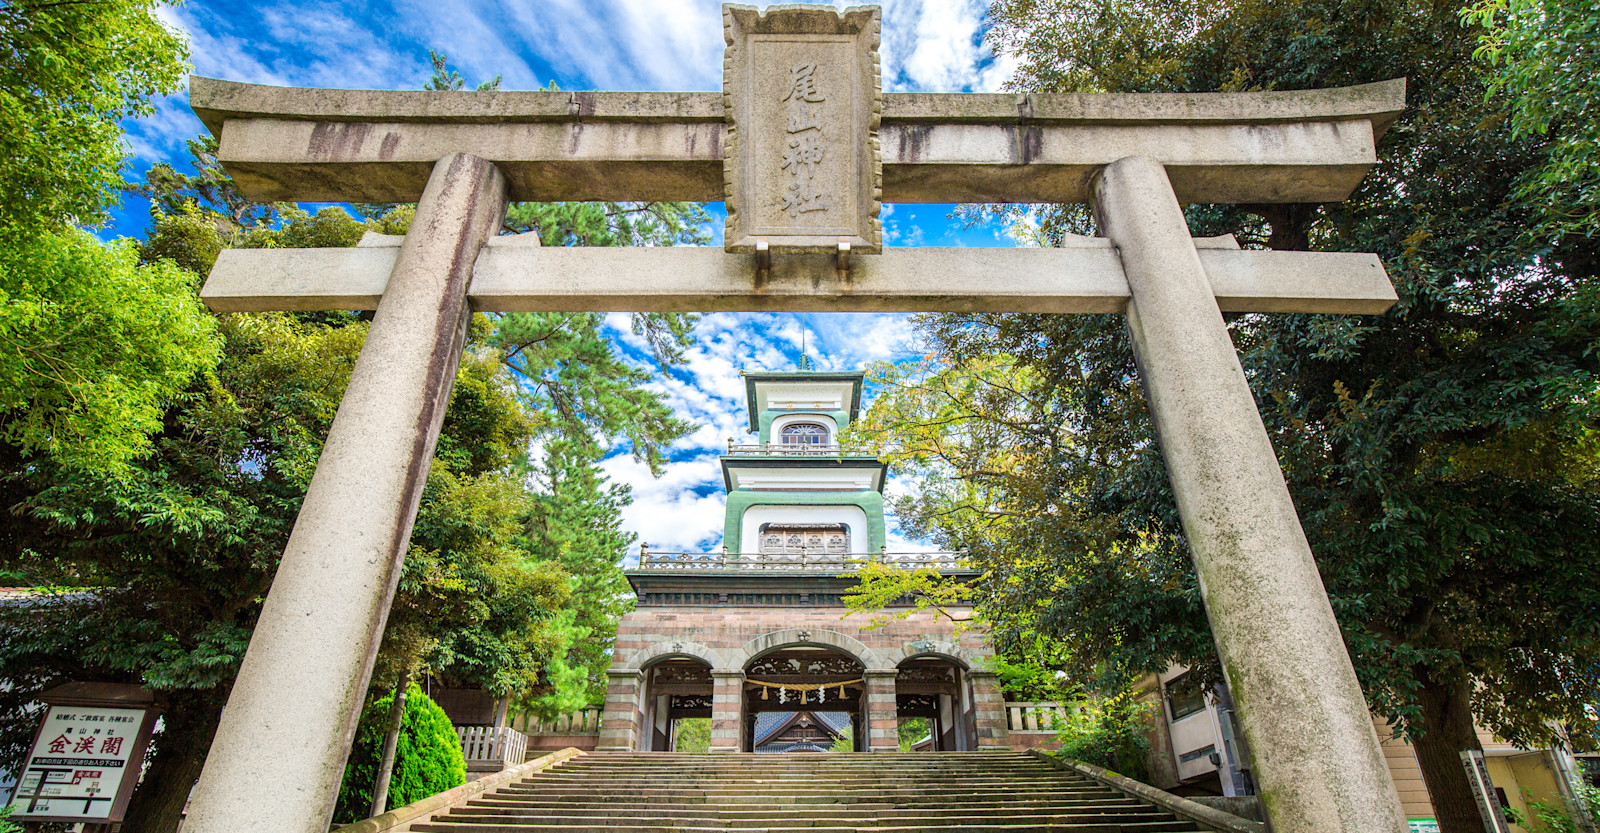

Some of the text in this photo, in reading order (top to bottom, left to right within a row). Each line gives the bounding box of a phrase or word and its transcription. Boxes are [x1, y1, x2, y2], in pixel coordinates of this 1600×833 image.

[781, 61, 829, 218] 尾山神社
[65, 727, 114, 735] 尾山神社
